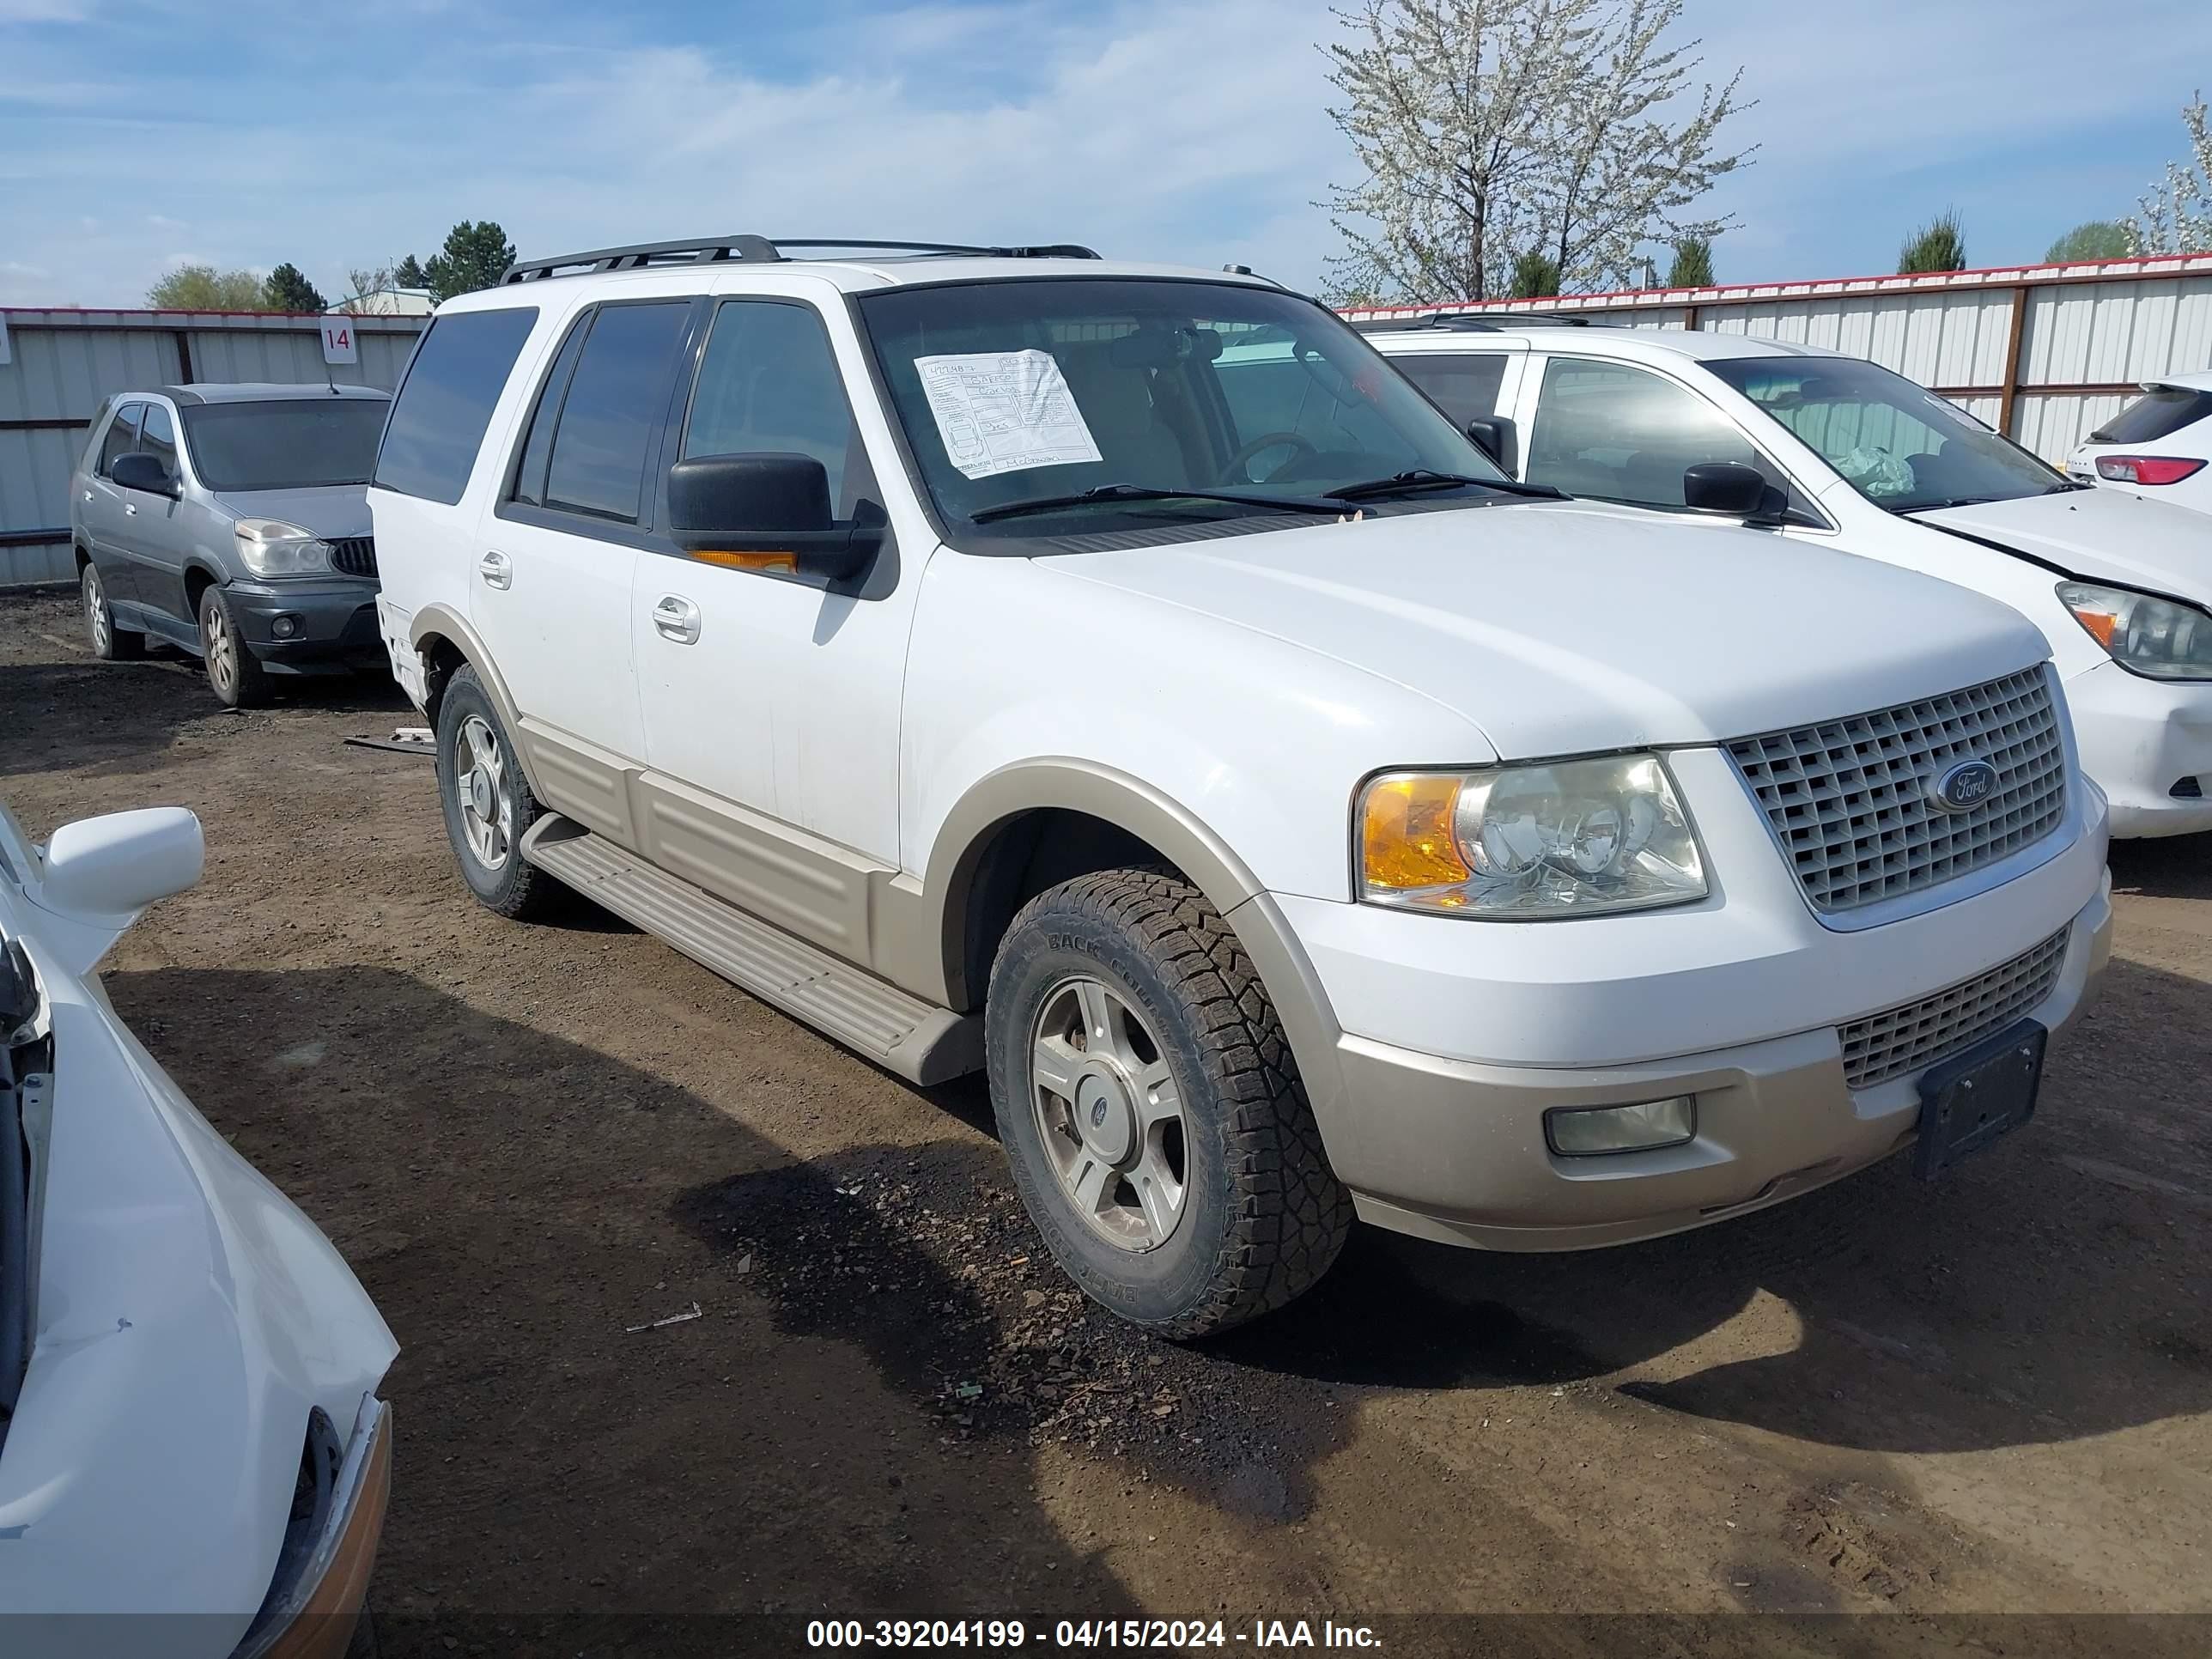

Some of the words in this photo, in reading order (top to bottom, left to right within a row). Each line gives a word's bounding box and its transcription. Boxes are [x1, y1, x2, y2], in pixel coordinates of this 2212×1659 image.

[327, 329, 349, 349] 14
[1956, 771, 1987, 800] Ford
[1047, 932, 1103, 958] BACK
